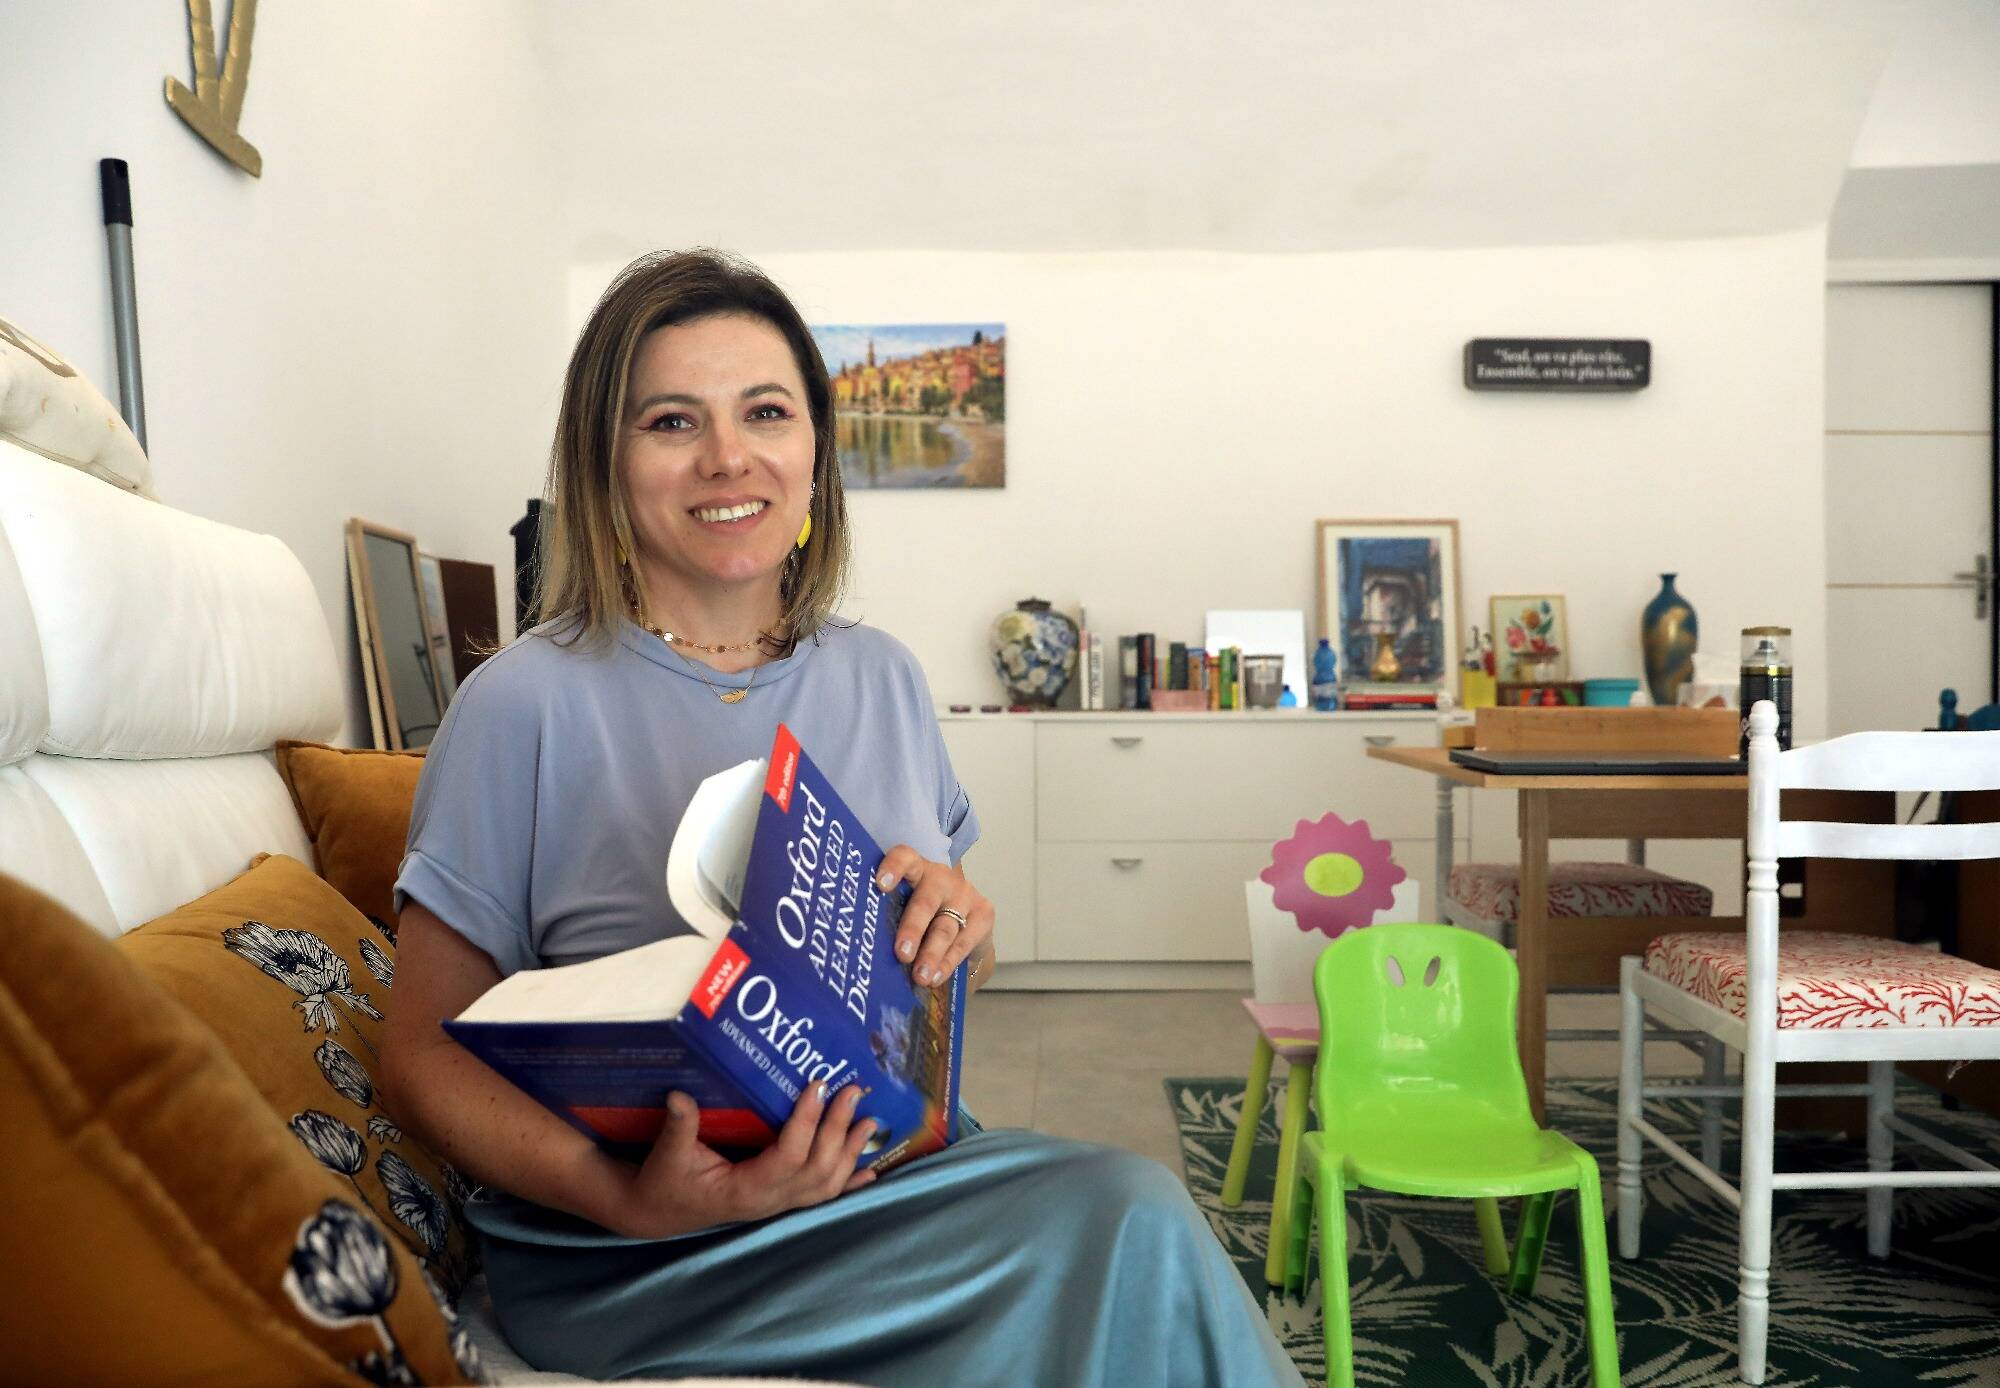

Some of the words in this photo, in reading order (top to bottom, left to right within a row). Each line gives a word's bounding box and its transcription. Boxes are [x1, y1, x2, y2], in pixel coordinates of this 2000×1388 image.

[1569, 349, 1595, 366] plus
[1578, 365, 1605, 382] plus
[776, 782, 826, 949] Oxford
[809, 820, 844, 980] ADVANCED
[828, 842, 862, 999] LEARNER'S
[707, 958, 734, 996] NEW
[847, 866, 885, 1024] Dictionar
[718, 1017, 771, 1071] ADVANCED
[737, 975, 848, 1085] Oxford
